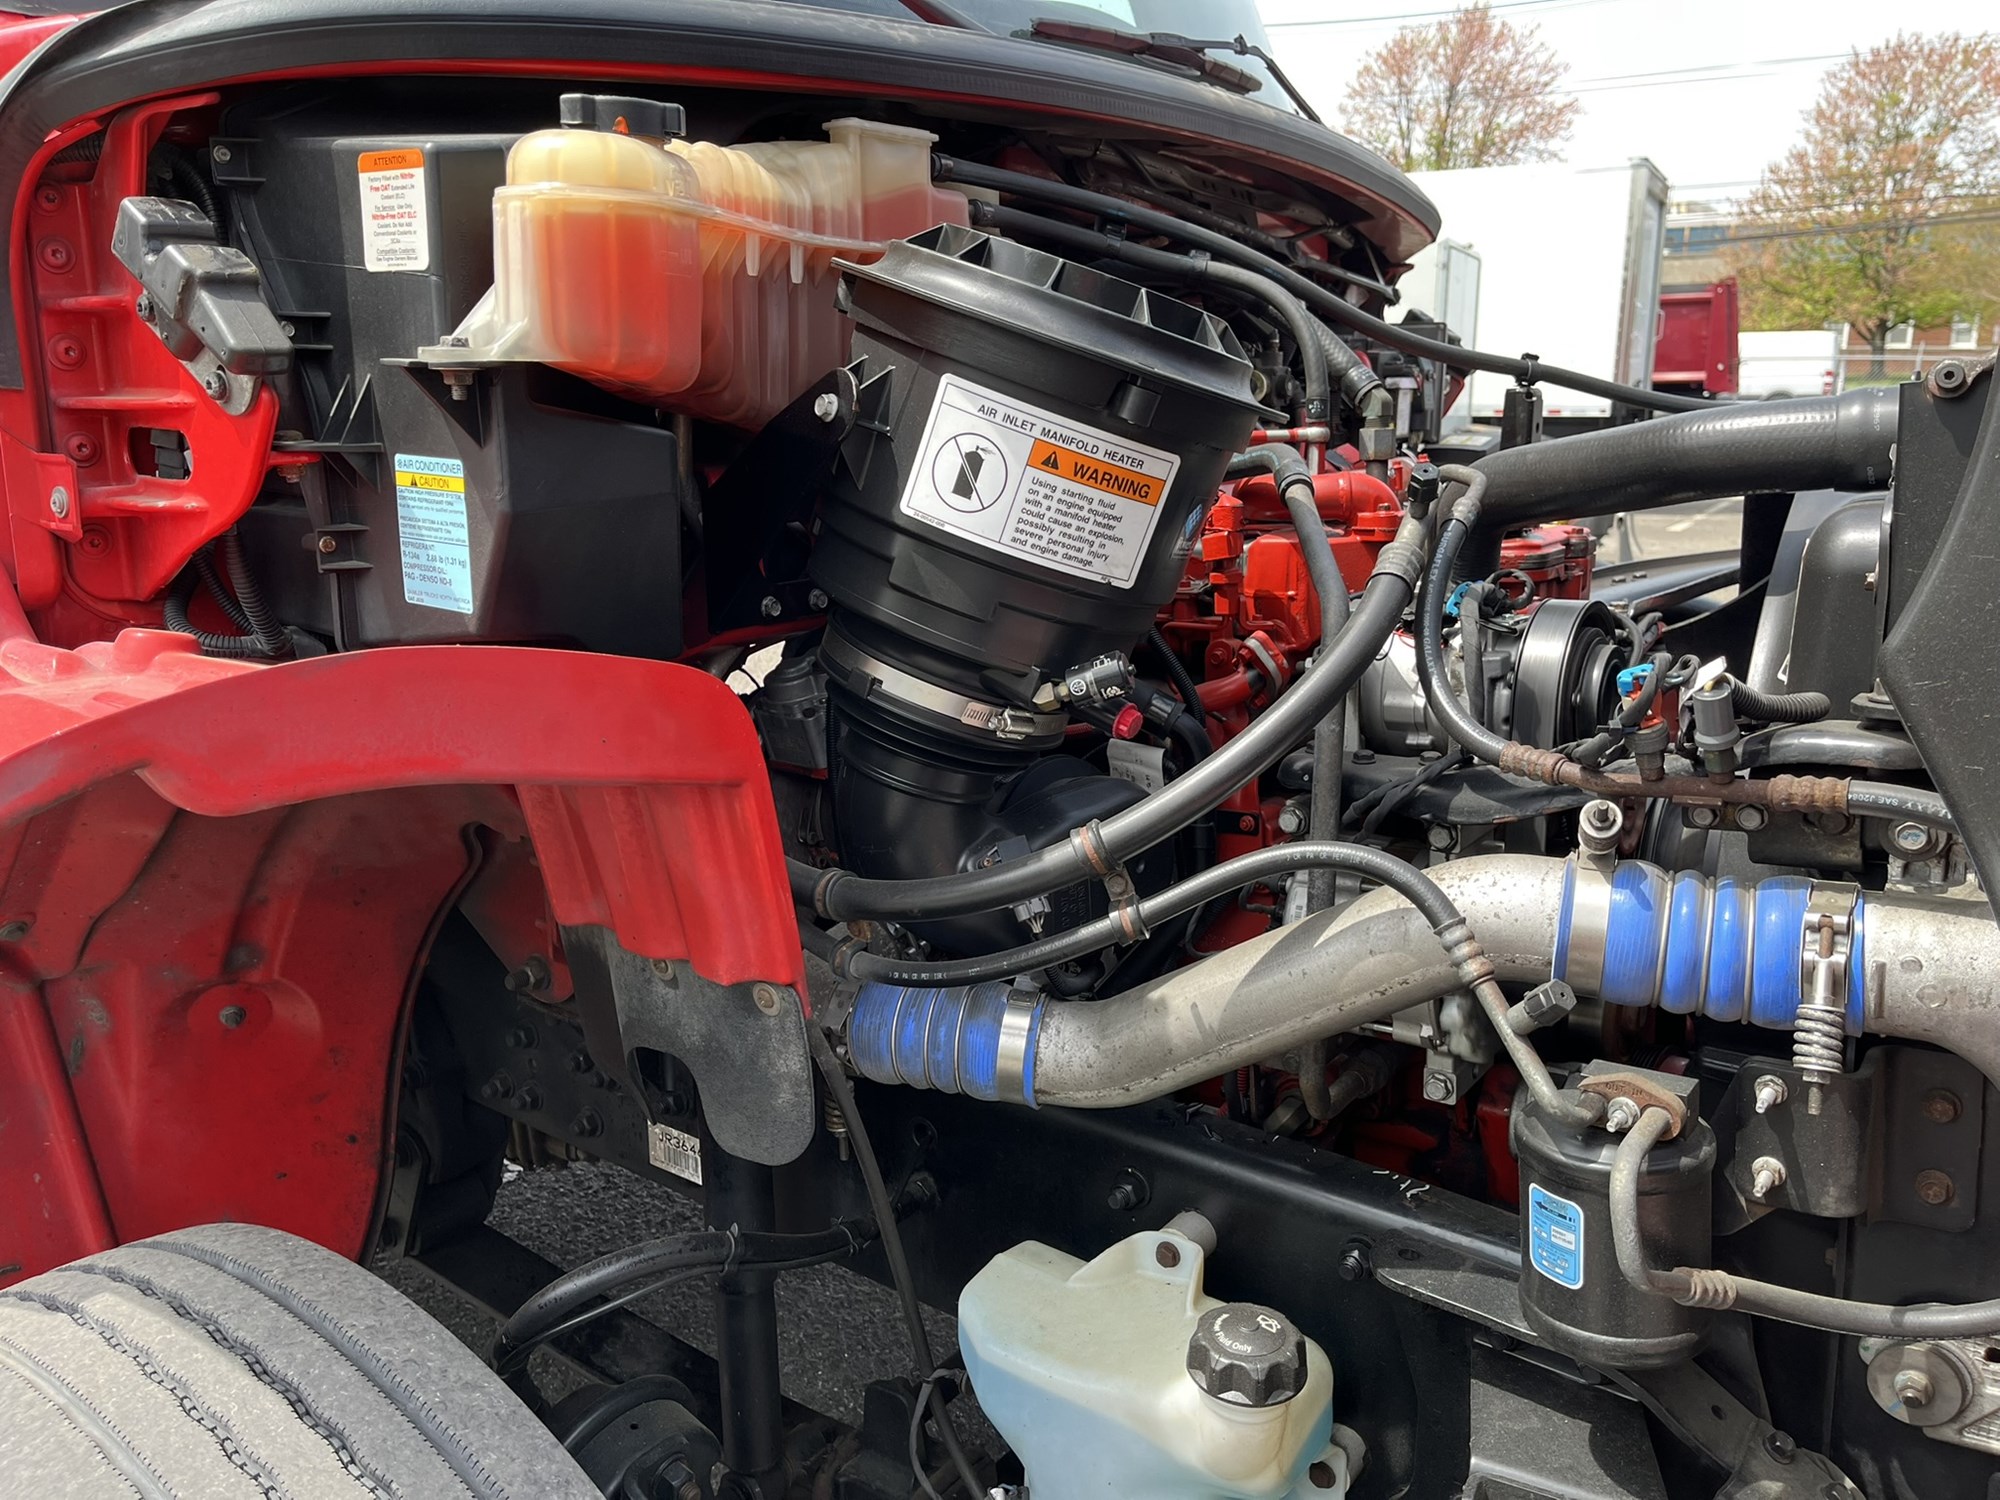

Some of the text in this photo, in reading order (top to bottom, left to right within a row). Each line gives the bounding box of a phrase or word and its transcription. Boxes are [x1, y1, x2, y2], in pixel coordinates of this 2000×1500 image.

[374, 156, 406, 165] ATTENTION
[978, 405, 1144, 468] AIR INLET MANIFOLD HEATER
[403, 460, 461, 474] AIR CONDITIONER
[418, 476, 449, 488] CAUTION
[1072, 462, 1151, 499] WARNING
[1028, 488, 1039, 496] on
[1057, 497, 1084, 511] engine
[1087, 506, 1122, 523] equipped
[1031, 477, 1115, 510] Using starting fluid
[1021, 506, 1045, 519] could
[1049, 516, 1072, 528] cause
[1088, 528, 1124, 545] explosion,
[1025, 497, 1043, 508] with
[1055, 507, 1089, 522] manifold
[1092, 519, 1115, 532] heater
[1014, 526, 1108, 562] severe personal injury
[1017, 516, 1106, 550] possibly resulting in
[402, 550, 419, 560] R-134a
[403, 561, 436, 573] COMPRESSOR
[1011, 536, 1094, 568] and engine damage.
[1430, 530, 1452, 581] SURGAFLEX
[404, 571, 415, 580] PAG
[419, 573, 438, 584] DENSO
[1878, 795, 1899, 806] SAE
[1606, 1082, 1624, 1092] OUT
[1216, 1330, 1252, 1353] Fluid Only
